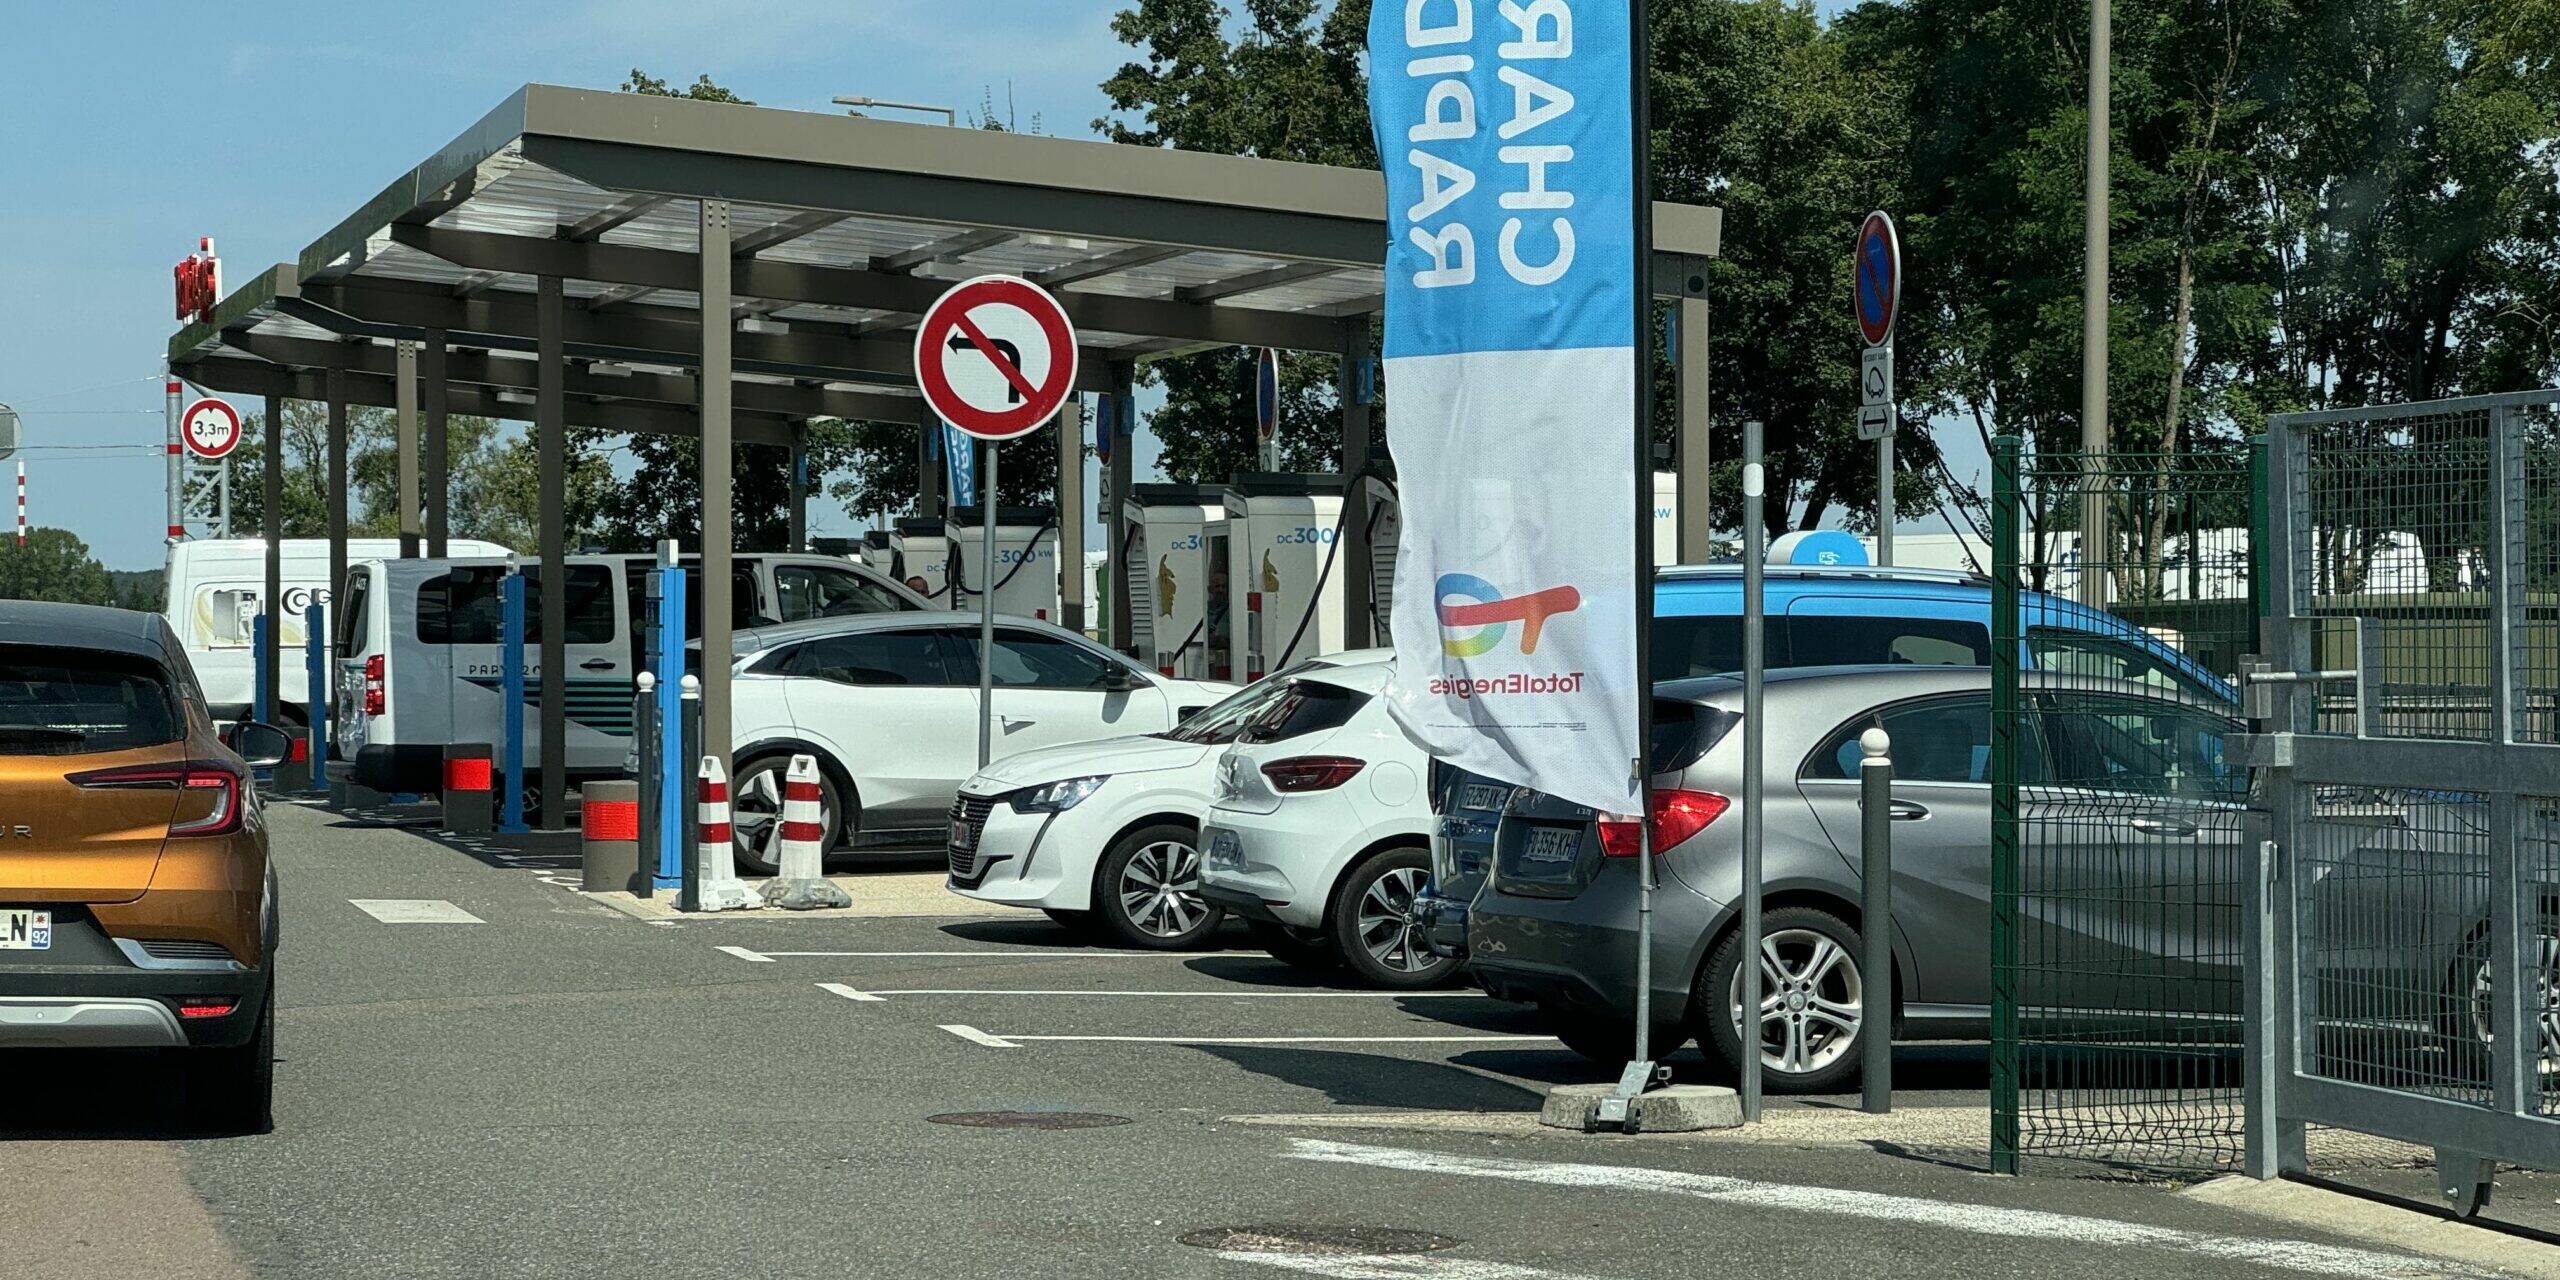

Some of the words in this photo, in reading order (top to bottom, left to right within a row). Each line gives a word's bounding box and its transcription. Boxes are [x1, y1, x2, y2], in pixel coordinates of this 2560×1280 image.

[194, 420, 229, 438] 3,3m
[1277, 534, 1293, 544] DC
[1294, 527, 1333, 544] 300
[1171, 540, 1187, 550] DC
[1001, 550, 1036, 563] 300
[32, 930, 48, 944] 92
